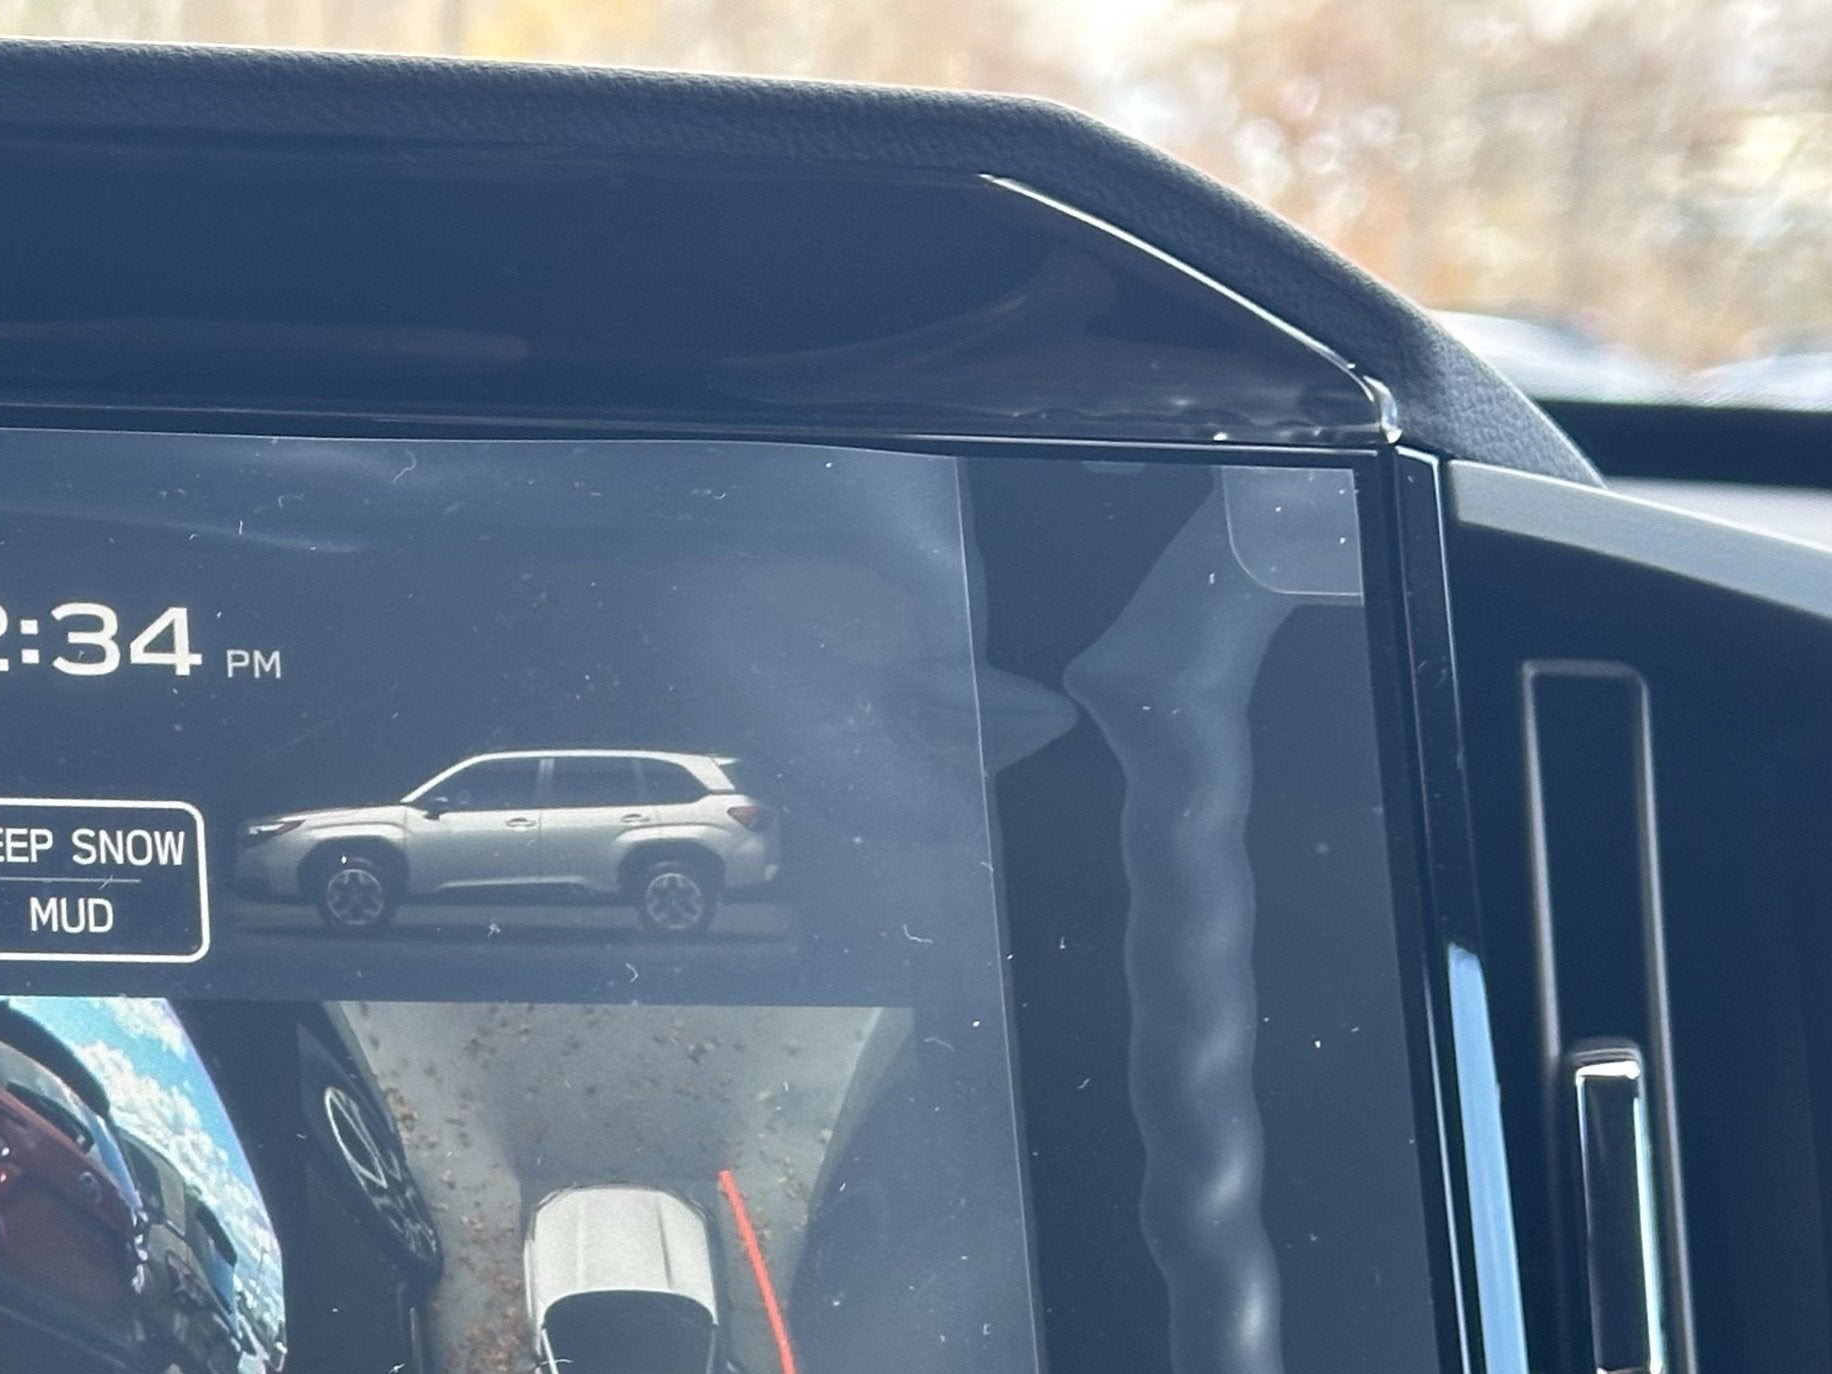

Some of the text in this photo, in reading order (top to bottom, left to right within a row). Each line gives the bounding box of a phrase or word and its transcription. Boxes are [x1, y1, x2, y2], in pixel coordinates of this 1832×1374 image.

[226, 648, 283, 680] PM
[70, 828, 186, 867] SNOW
[29, 897, 115, 936] MUD
